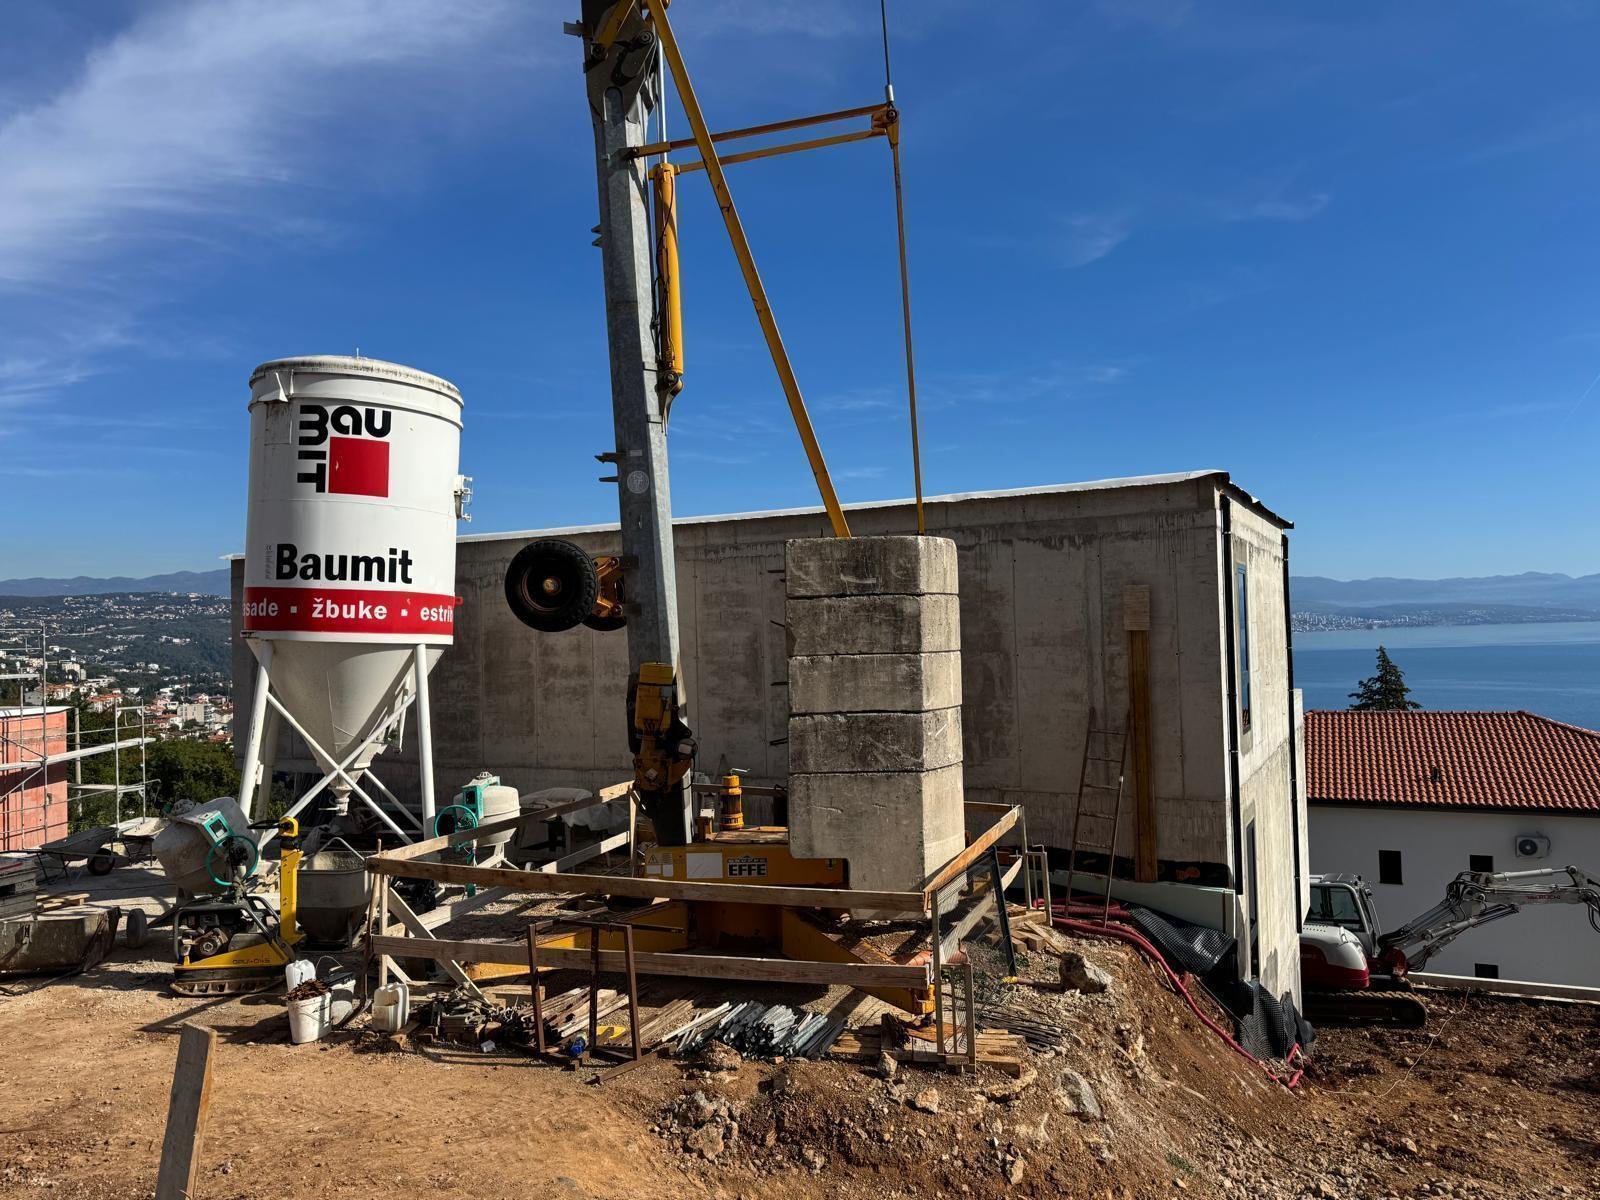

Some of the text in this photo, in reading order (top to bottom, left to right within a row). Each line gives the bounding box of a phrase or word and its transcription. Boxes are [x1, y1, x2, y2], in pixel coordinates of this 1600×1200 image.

[276, 543, 412, 584] Baumit
[312, 597, 388, 620] žbuke
[729, 863, 766, 876] EFFE
